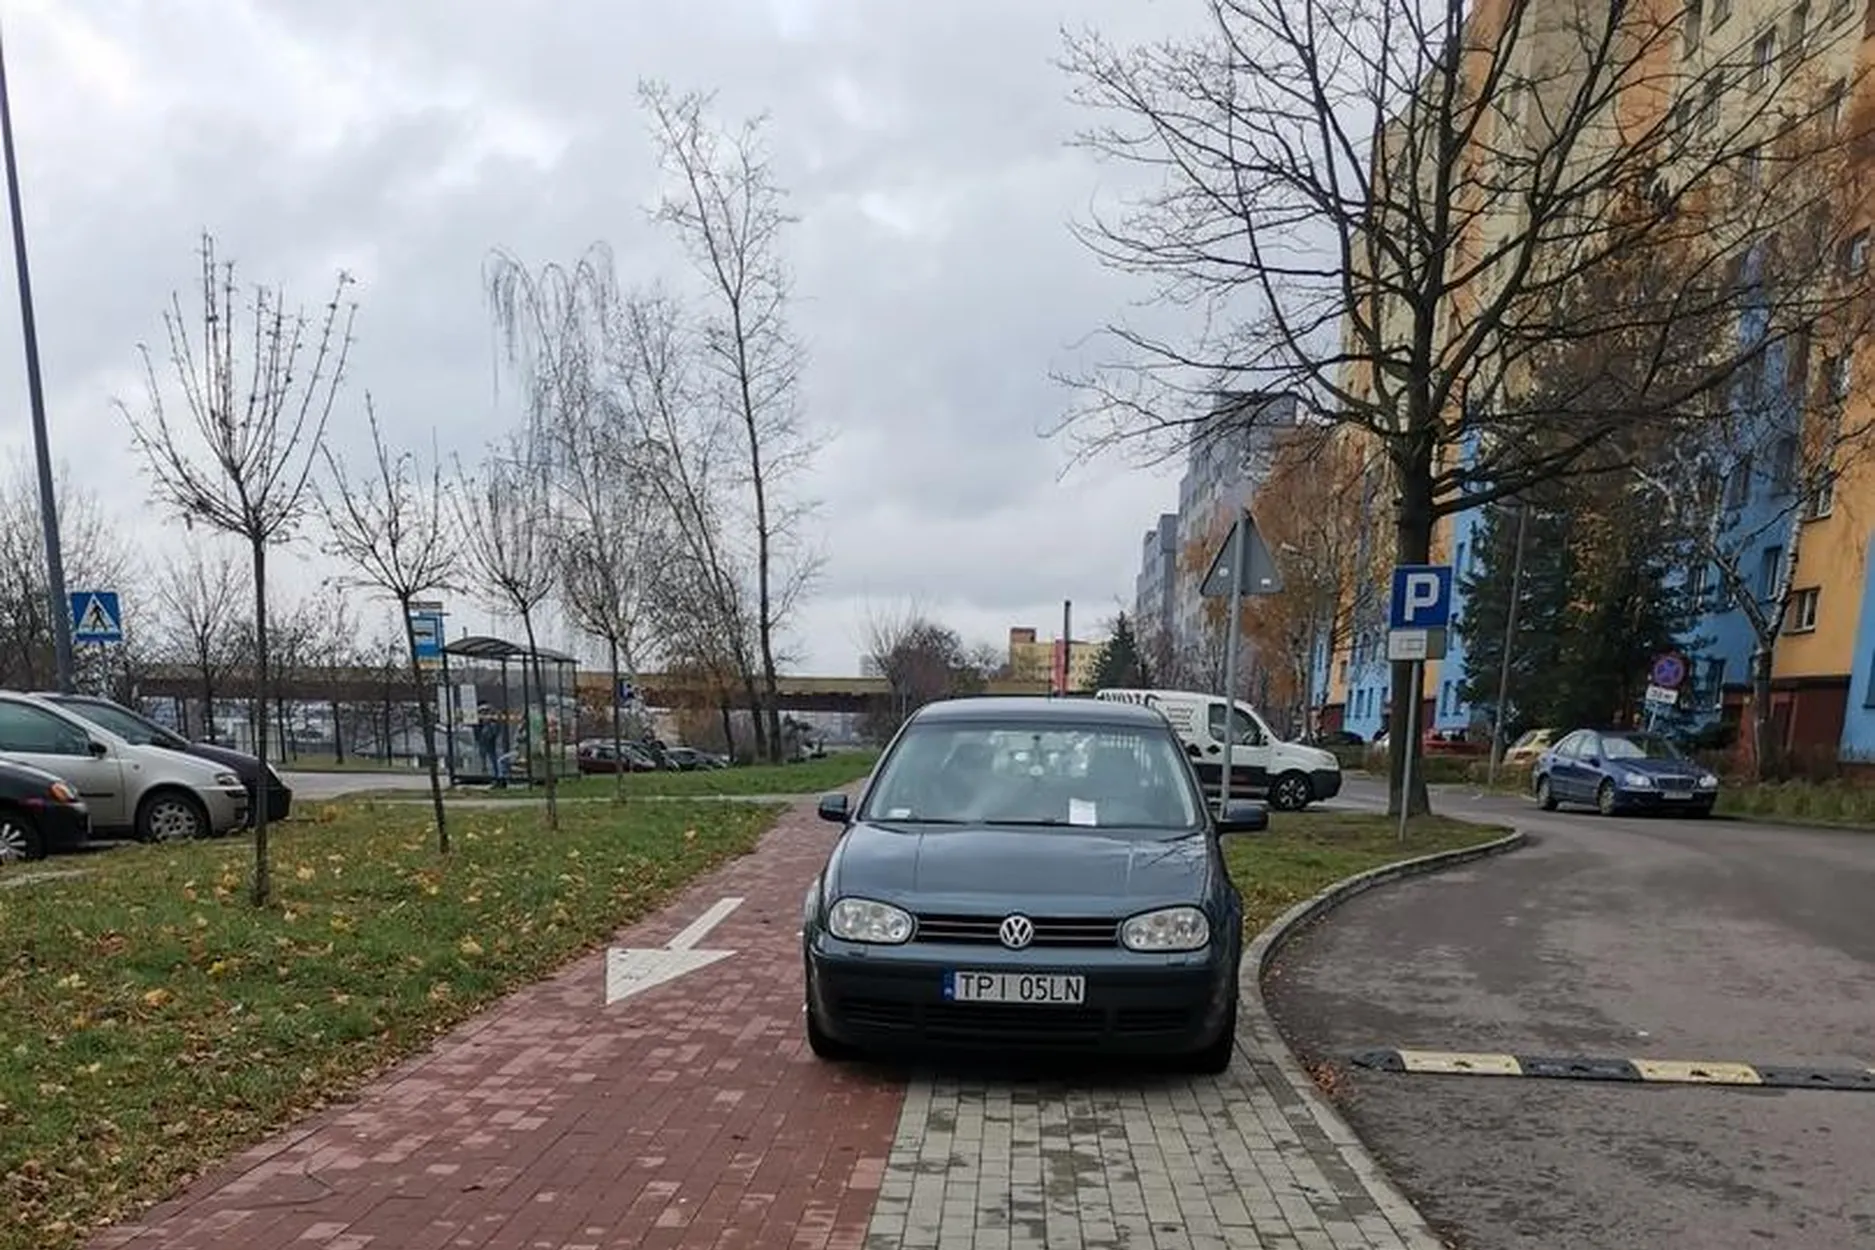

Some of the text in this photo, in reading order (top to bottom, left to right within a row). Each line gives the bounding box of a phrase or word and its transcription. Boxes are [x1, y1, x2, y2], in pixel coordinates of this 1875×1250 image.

[1404, 573, 1440, 622] P
[960, 974, 1082, 1001] TPI 05LN
